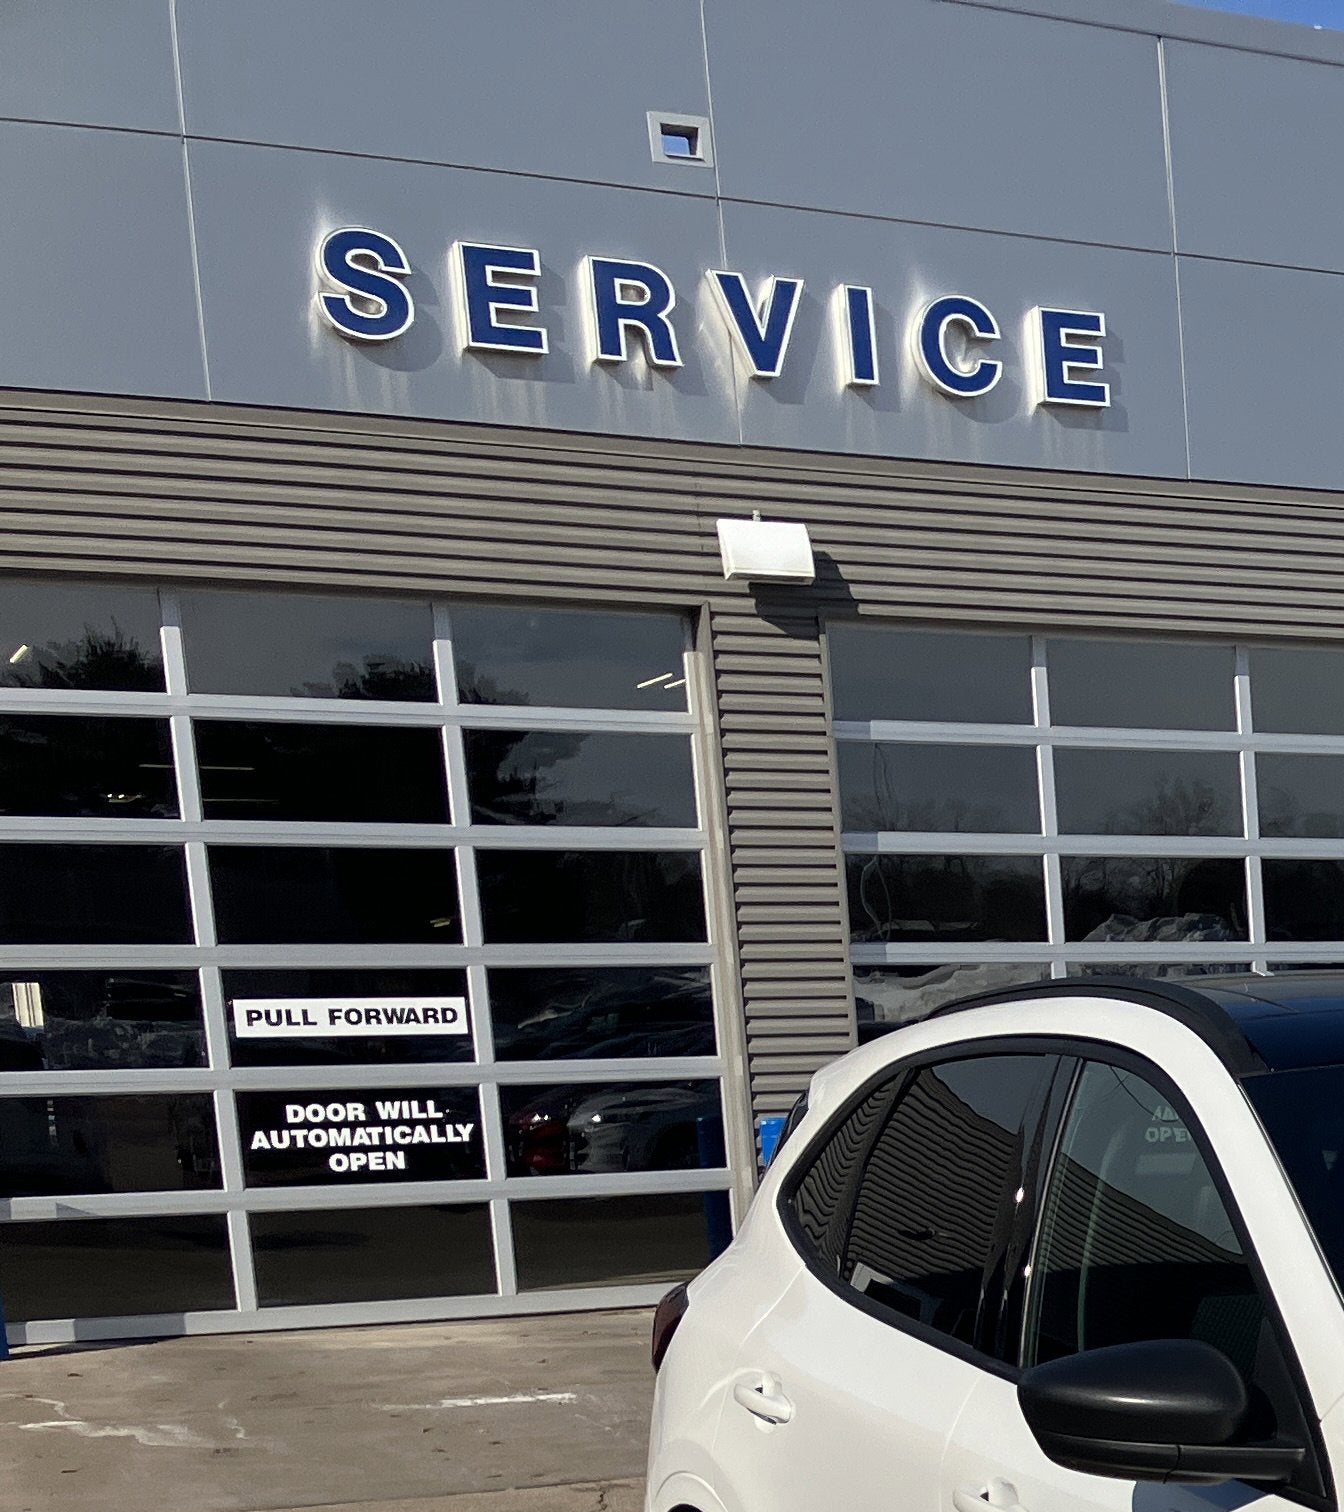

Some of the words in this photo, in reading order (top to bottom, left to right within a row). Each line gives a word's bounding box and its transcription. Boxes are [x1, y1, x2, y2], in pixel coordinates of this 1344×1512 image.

[317, 226, 1111, 407] SERVICE
[246, 1008, 317, 1027] PULL
[328, 1007, 458, 1026] FORWARD
[285, 1103, 366, 1124] DOOR
[375, 1100, 444, 1120] WILL
[251, 1123, 475, 1150] AUTOMATICALLY
[1144, 1127, 1192, 1143] OPE
[328, 1151, 406, 1173] OPEN
